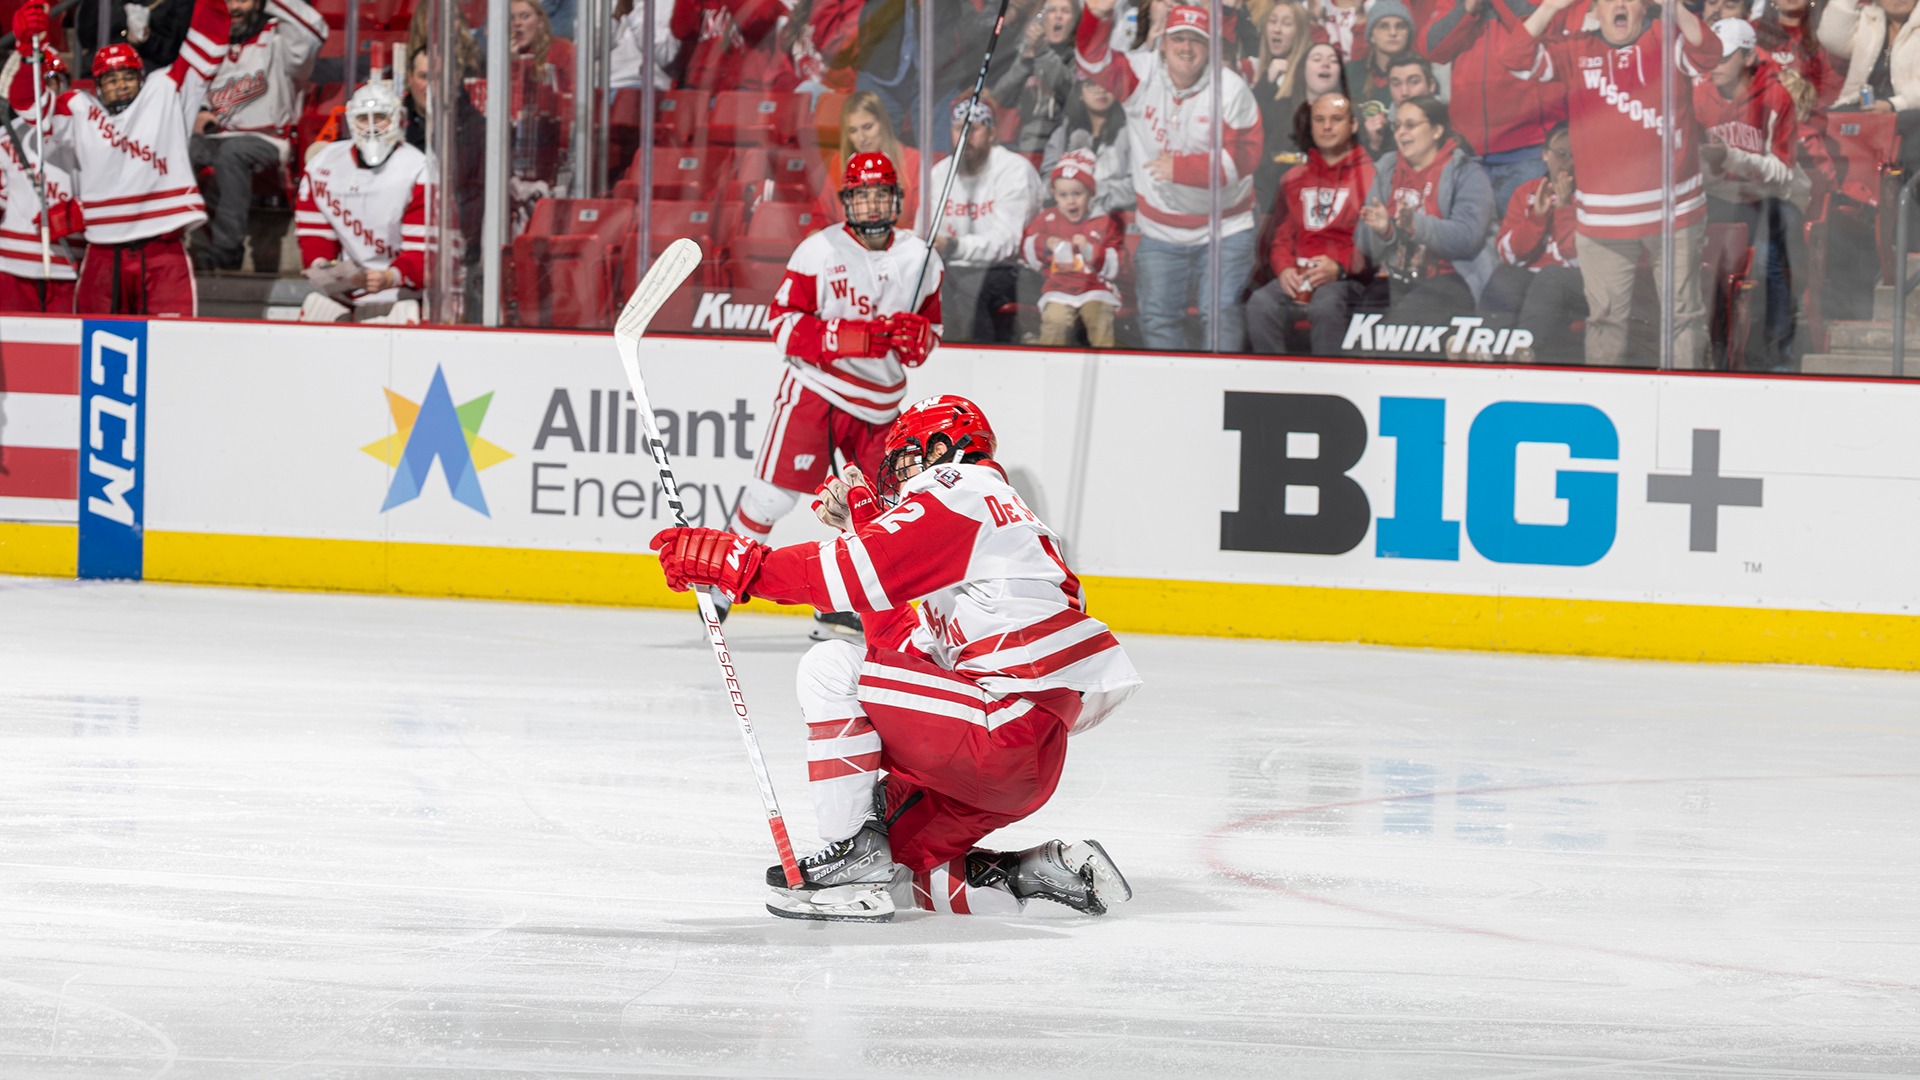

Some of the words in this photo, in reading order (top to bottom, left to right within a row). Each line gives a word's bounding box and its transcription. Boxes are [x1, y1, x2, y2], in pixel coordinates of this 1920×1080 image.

[88, 105, 168, 175] WISCONSIN
[1341, 313, 1449, 353] KWIK
[1450, 316, 1535, 355] TRIP
[88, 330, 138, 526] CCM
[705, 612, 748, 717] JETSPEED
